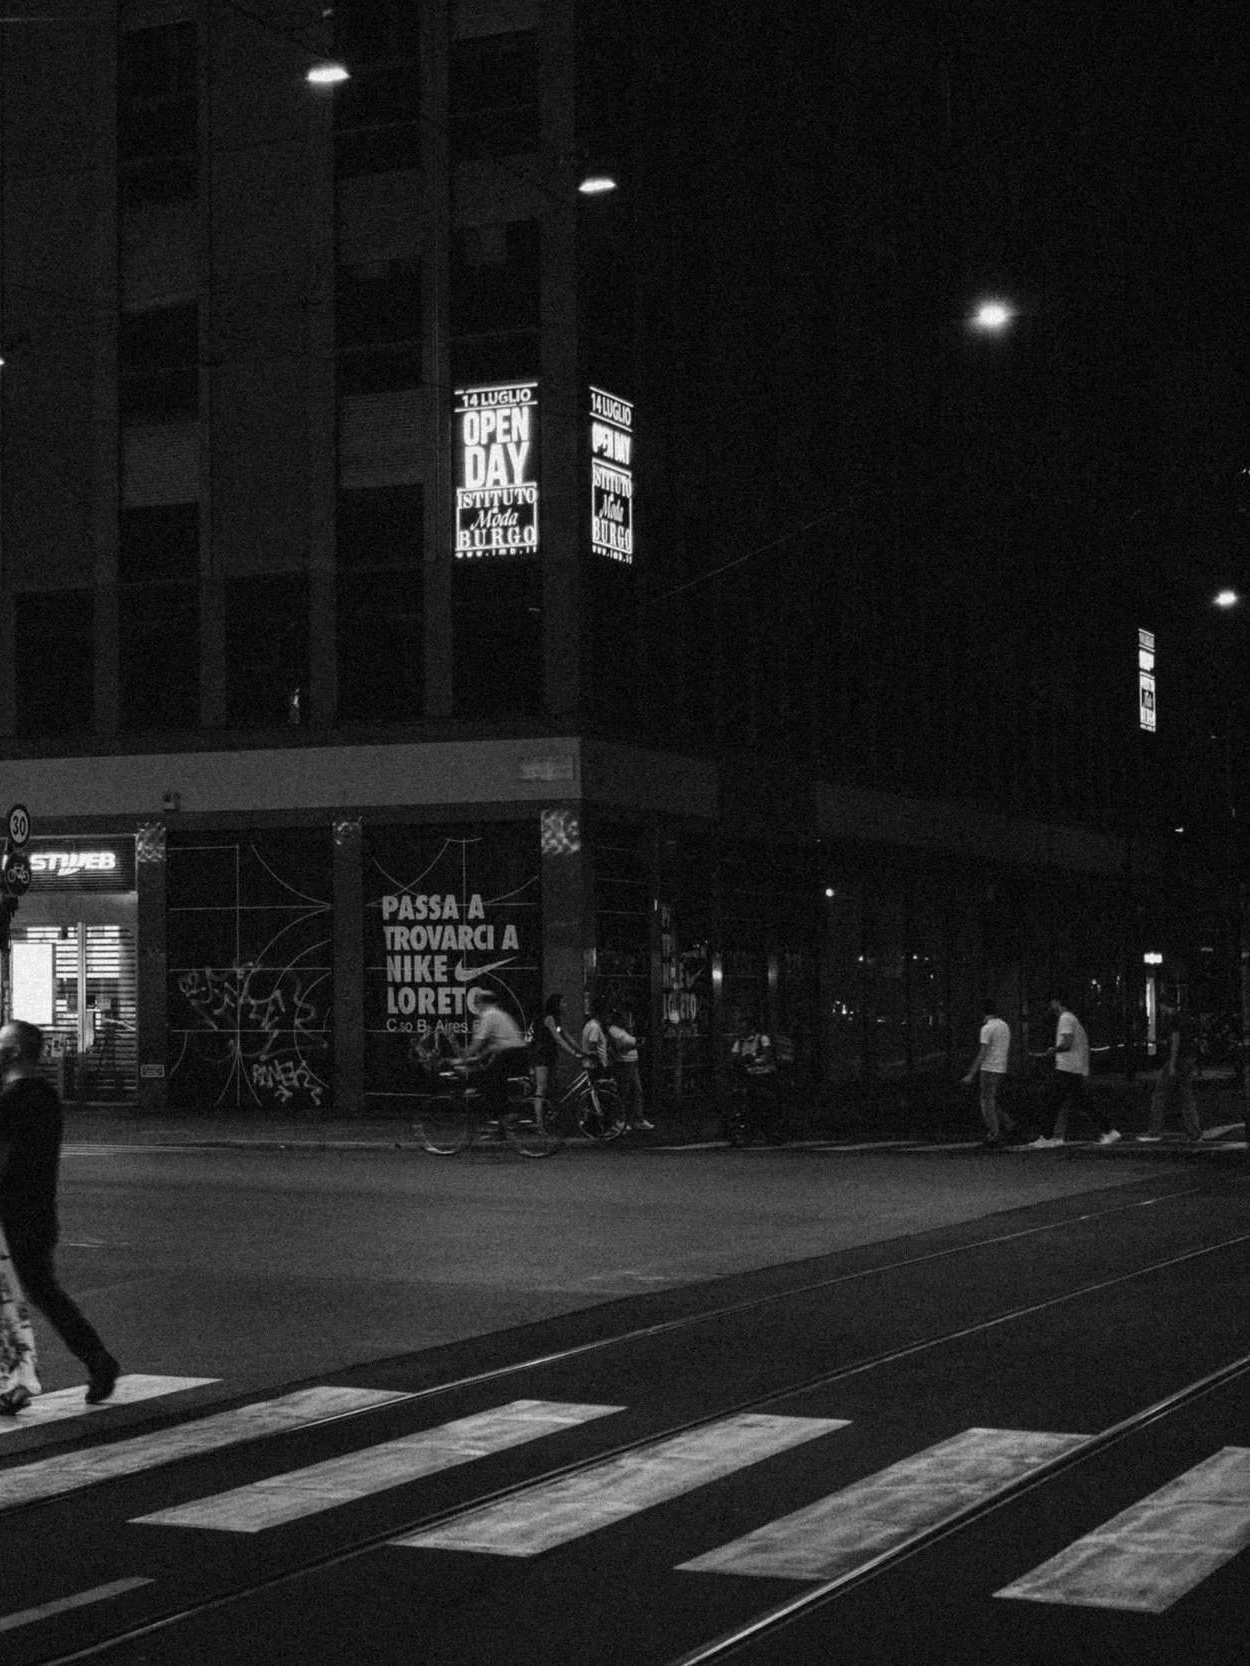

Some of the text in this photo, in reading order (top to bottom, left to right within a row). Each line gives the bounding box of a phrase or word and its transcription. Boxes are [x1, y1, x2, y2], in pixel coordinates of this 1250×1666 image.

[462, 388, 532, 408] 14 LUGLIO
[602, 396, 632, 426] LUGLIO
[463, 407, 530, 446] OPEN
[464, 443, 530, 489] DAY
[593, 465, 633, 499] ISTITUTO
[457, 487, 538, 509] ISTITUTO
[599, 494, 624, 523] Moda
[470, 507, 519, 531] Moda
[458, 526, 536, 549] BURGO
[593, 517, 632, 551] BURGO
[12, 815, 26, 837] 30
[2, 851, 117, 876] STWEB
[382, 894, 485, 920] PASSA A
[383, 925, 519, 951] TROVARCI A
[386, 955, 448, 983] NIKE
[435, 1018, 468, 1033] Aires
